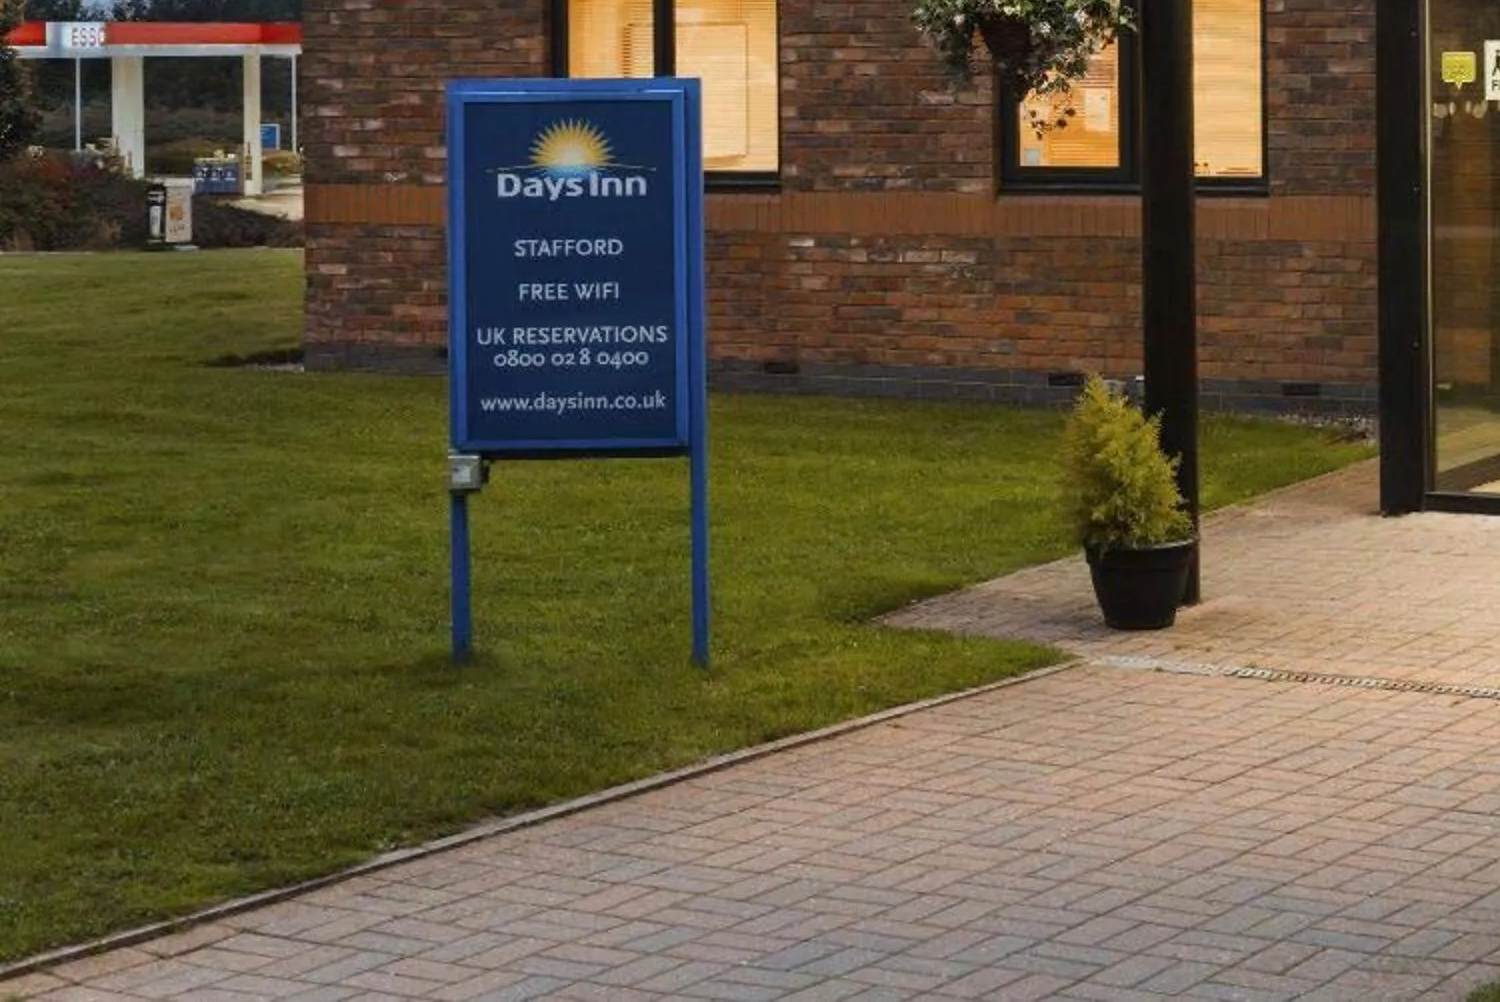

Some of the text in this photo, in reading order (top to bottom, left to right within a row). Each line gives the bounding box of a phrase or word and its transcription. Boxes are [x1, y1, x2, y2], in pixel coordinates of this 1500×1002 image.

[497, 172, 647, 201] Days Inn
[514, 239, 624, 257] STAFFORD
[519, 281, 620, 301] FREE WIFI
[477, 325, 668, 345] UK RESERVATIONS
[493, 349, 545, 367] 0800
[597, 351, 649, 370] 0400
[480, 390, 667, 415] www.daysinn.co.uk
